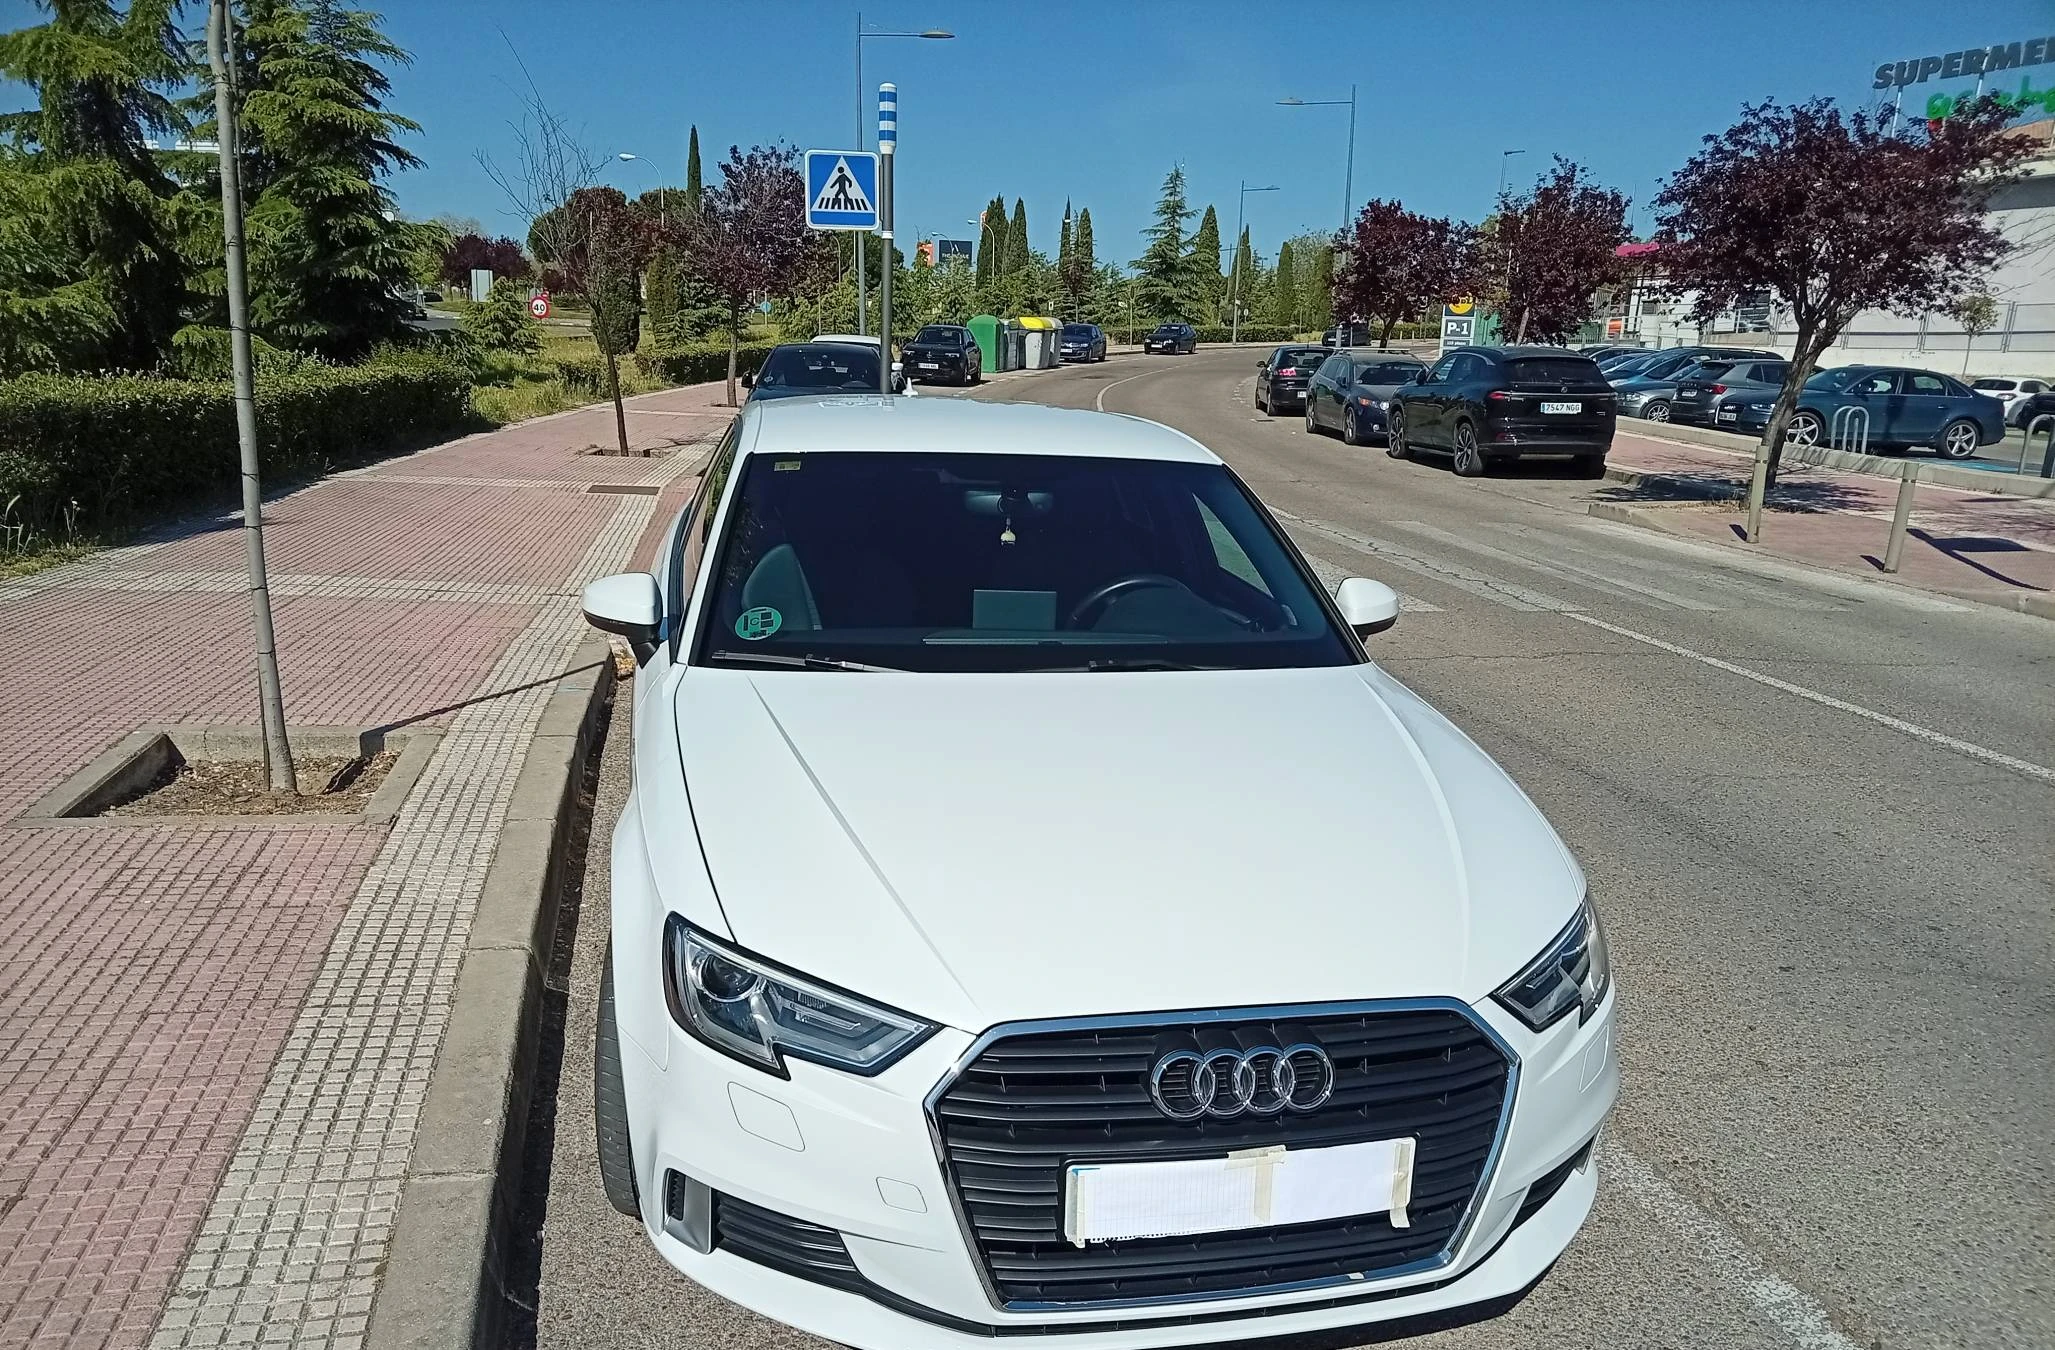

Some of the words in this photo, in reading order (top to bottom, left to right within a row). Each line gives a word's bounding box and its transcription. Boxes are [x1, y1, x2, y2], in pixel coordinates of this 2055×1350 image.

[534, 303, 545, 312] 40
[1446, 321, 1469, 335] P-1
[1546, 403, 1565, 412] 7547
